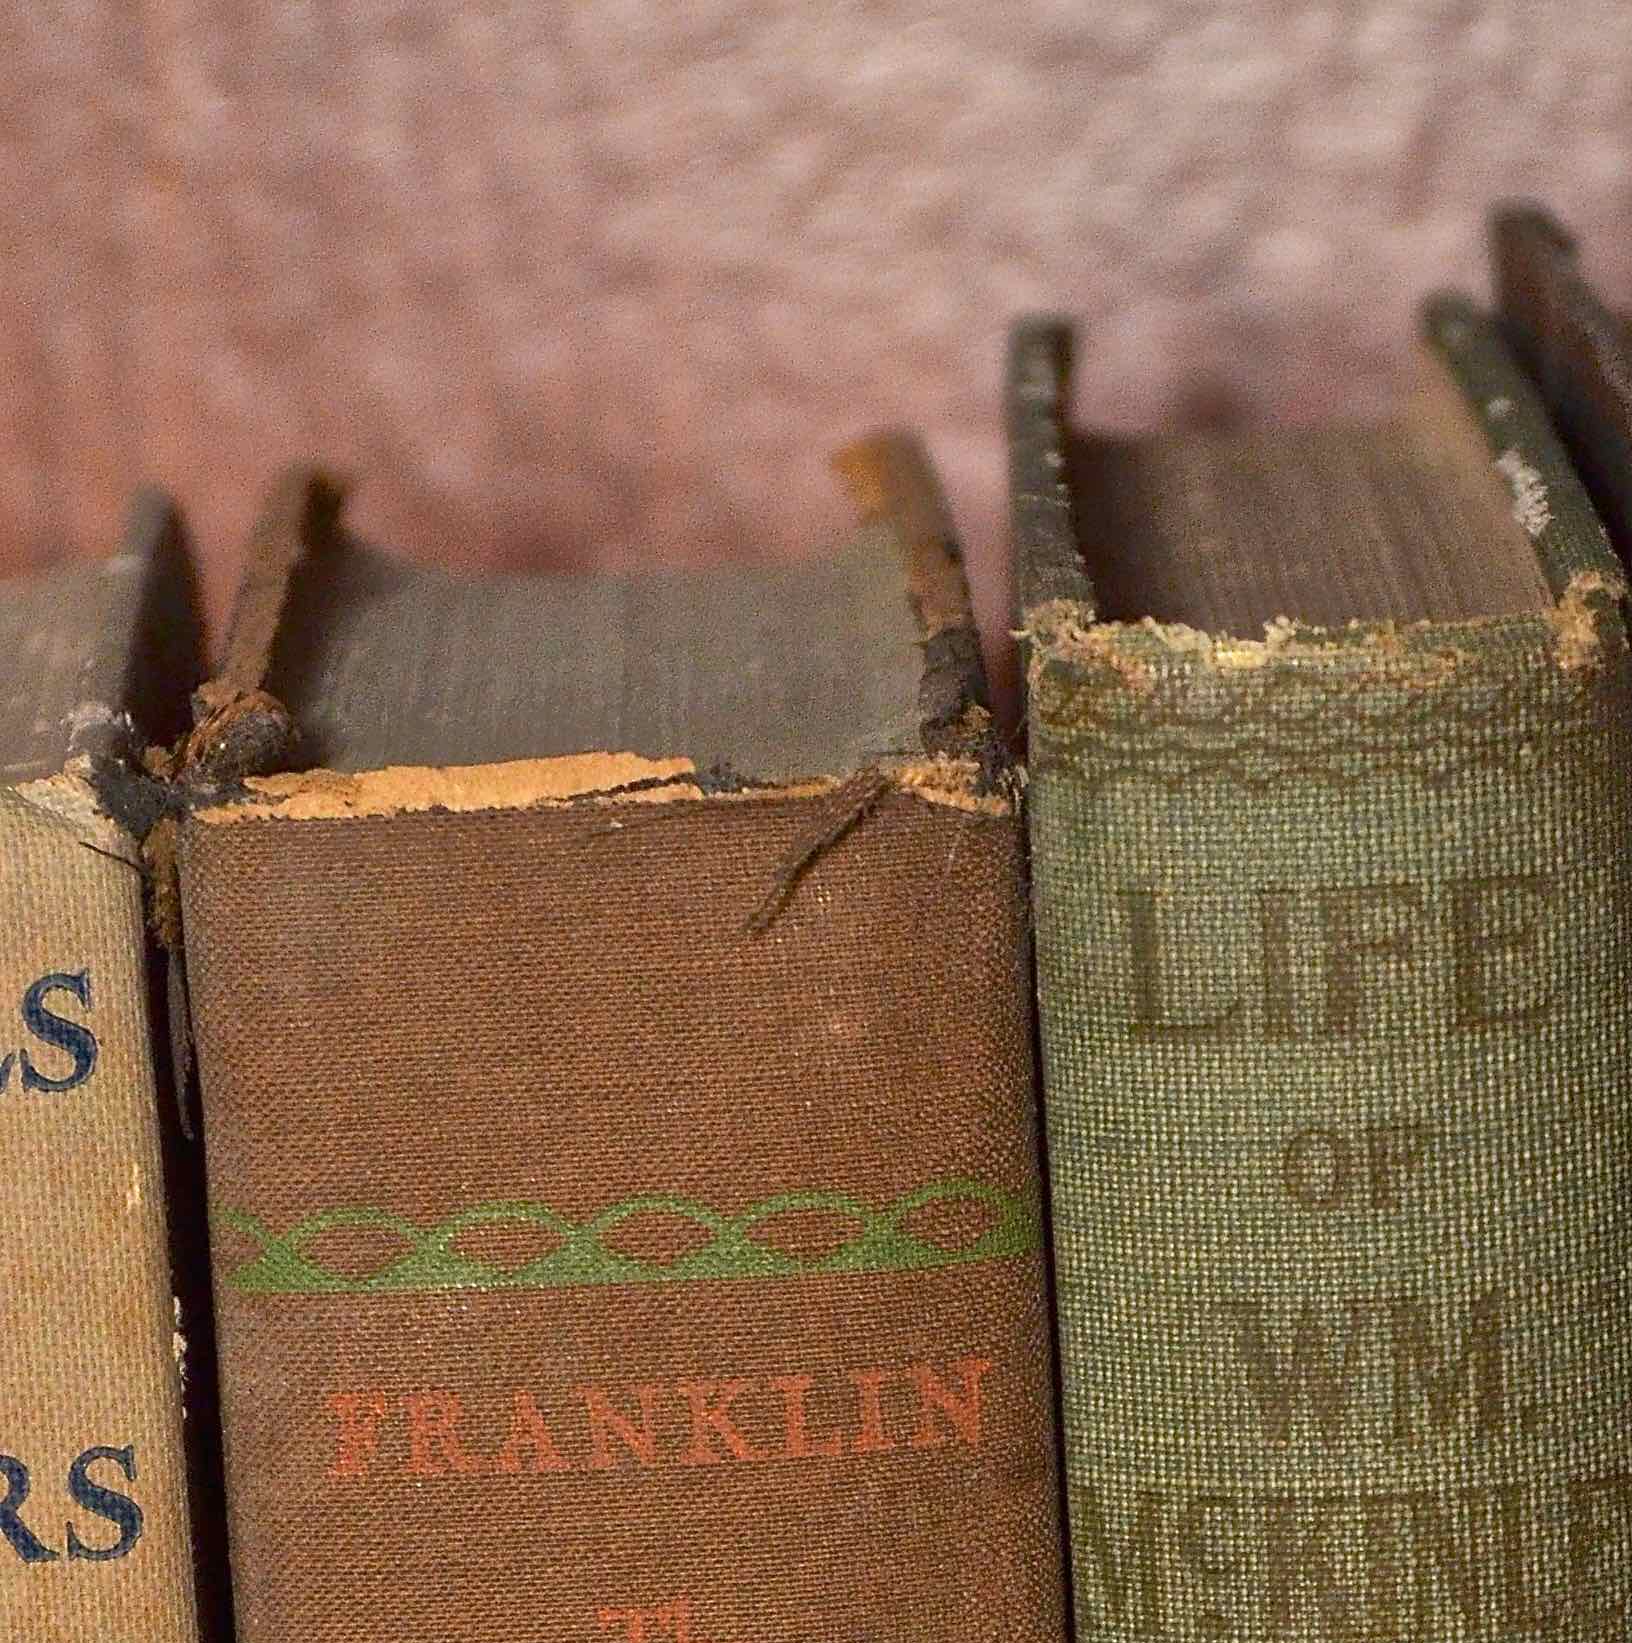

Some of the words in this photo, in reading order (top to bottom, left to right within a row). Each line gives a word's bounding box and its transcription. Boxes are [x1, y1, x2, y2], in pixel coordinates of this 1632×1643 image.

[1117, 872, 1554, 1043] LIFE
[1281, 1117, 1430, 1211] OF
[325, 1357, 992, 1477] FRANKLIN
